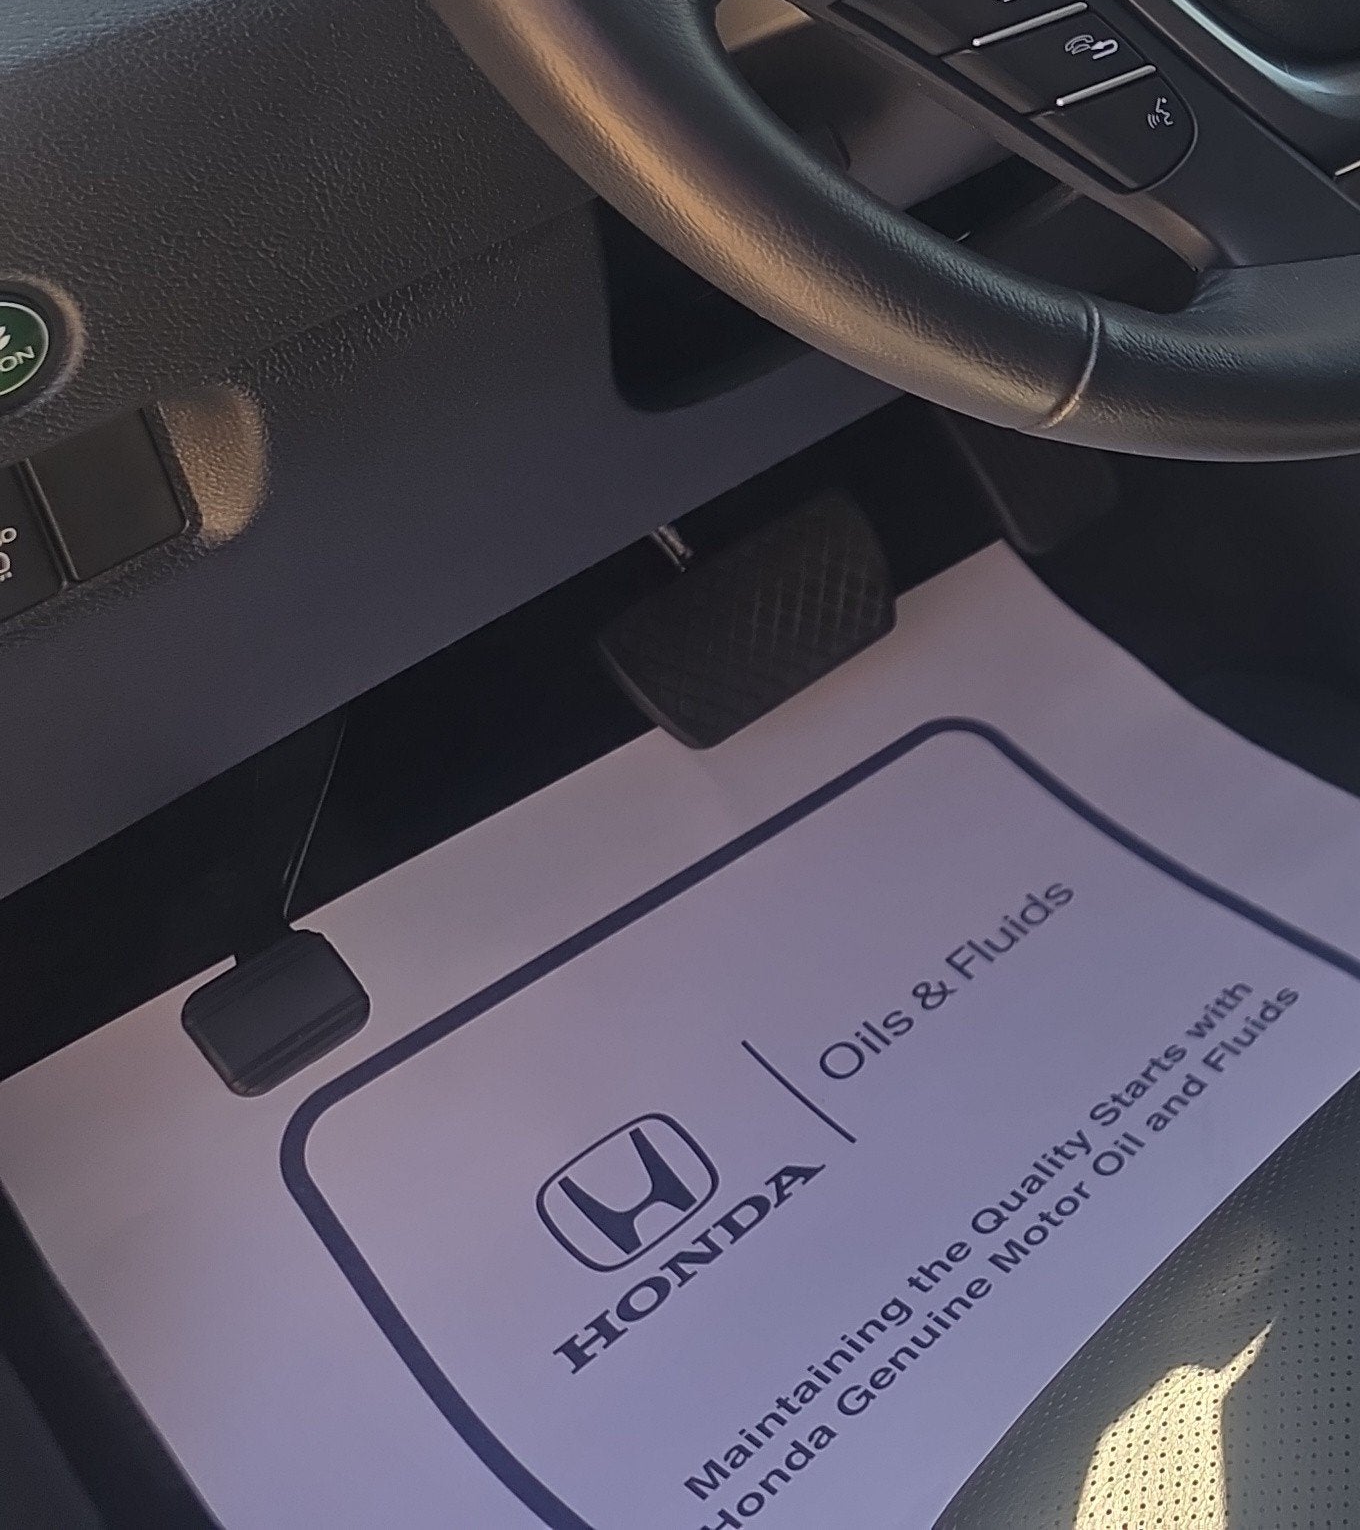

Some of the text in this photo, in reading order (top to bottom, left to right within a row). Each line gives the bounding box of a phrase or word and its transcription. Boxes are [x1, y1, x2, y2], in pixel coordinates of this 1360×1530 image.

[0, 345, 35, 372] ON
[818, 878, 1075, 1081] Oils & Fluids
[552, 1161, 828, 1375] HONDA
[683, 978, 1254, 1501] Maintaining the Quality Starts with
[700, 986, 1300, 1530] Honda Genuine Motor Oil and Fluids
